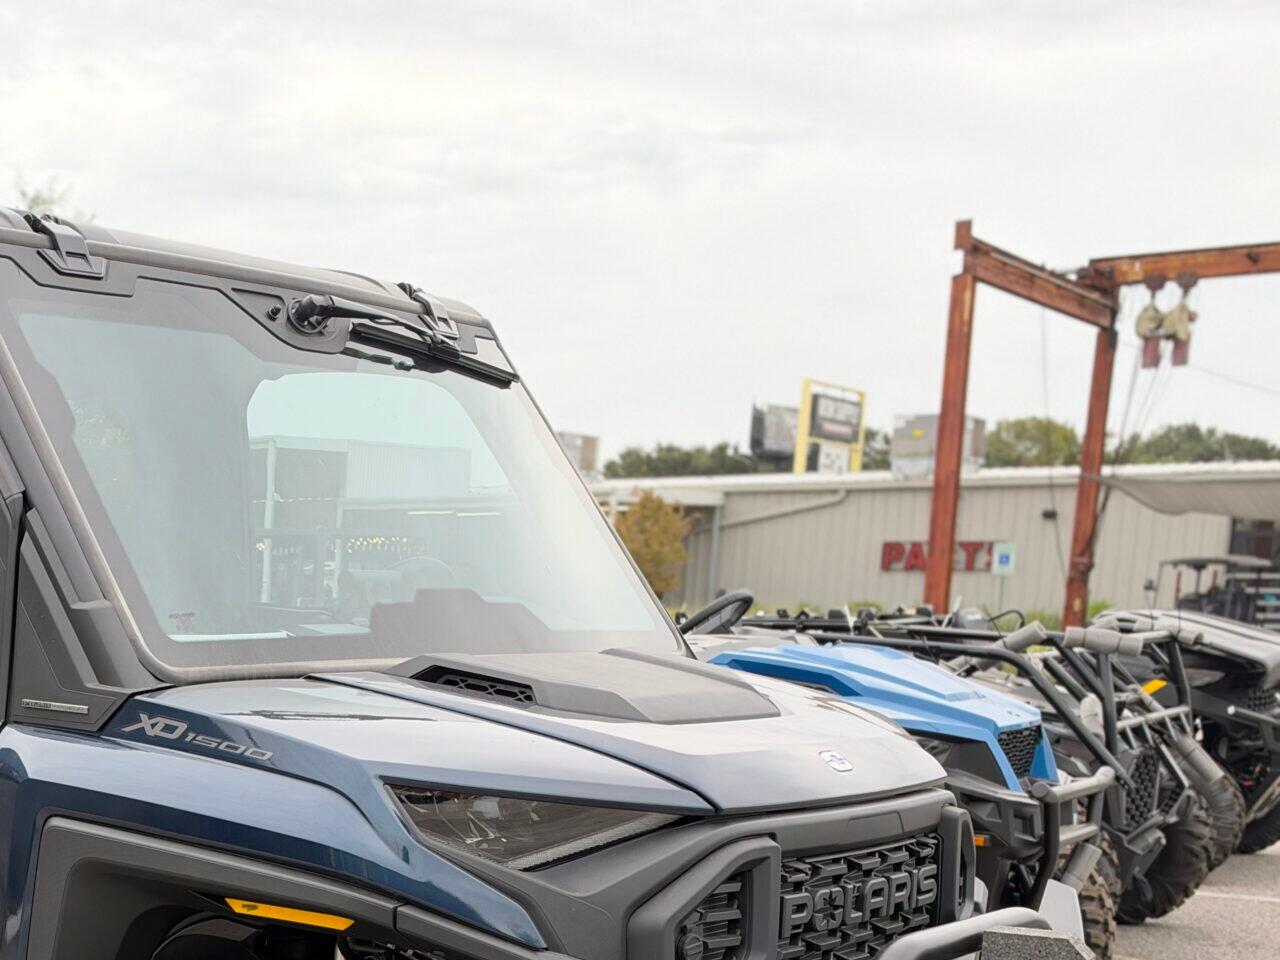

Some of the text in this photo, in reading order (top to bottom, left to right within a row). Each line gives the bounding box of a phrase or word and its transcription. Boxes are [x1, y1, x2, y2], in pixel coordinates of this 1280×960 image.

[881, 541, 993, 573] PAT
[120, 712, 274, 761] XD 1500
[781, 863, 938, 939] POLARIS
